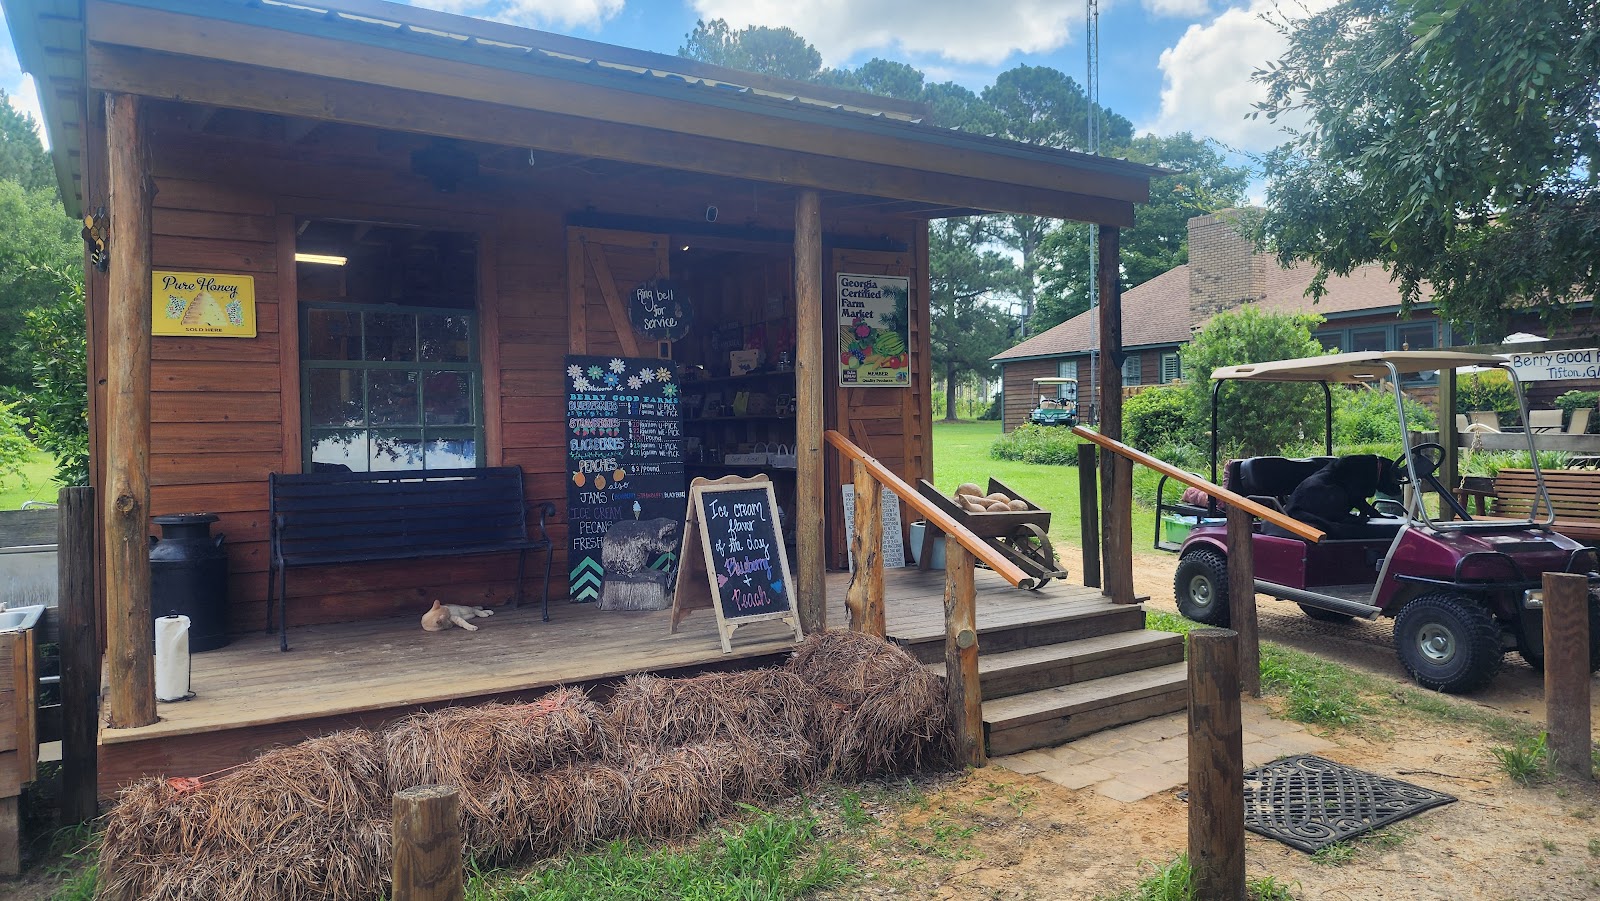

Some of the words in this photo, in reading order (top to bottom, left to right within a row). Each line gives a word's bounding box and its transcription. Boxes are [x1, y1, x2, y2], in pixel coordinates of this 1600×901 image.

[162, 275, 196, 291] Pure
[196, 277, 238, 299] Honey
[841, 278, 878, 290] Georgia
[636, 288, 654, 312] Ring
[656, 289, 674, 301] bell
[841, 288, 882, 299] Certified
[652, 304, 667, 317] for
[841, 299, 865, 308] Farm
[841, 308, 874, 319] Market
[643, 316, 678, 330] service
[1513, 355, 1553, 368] Berry
[1556, 351, 1591, 364] Good
[615, 383, 625, 391] to
[568, 400, 618, 411] BLUEBERRIES
[570, 393, 607, 401] BERRY
[643, 396, 678, 404] FARMS
[569, 417, 621, 429] STRAWBERRIES
[570, 436, 625, 451] BLACKBERRIES
[579, 457, 619, 474] PEACHES
[607, 481, 629, 490] also
[579, 491, 608, 505] JAMS
[570, 507, 591, 520] ICE
[593, 506, 623, 520] CREAM
[709, 499, 729, 520] Ice
[733, 501, 766, 521] cream
[727, 518, 755, 541] flavor
[573, 536, 604, 551] FRESH
[715, 539, 726, 557] of
[728, 537, 744, 553] the
[746, 534, 770, 561] day
[731, 585, 771, 611] Peach
